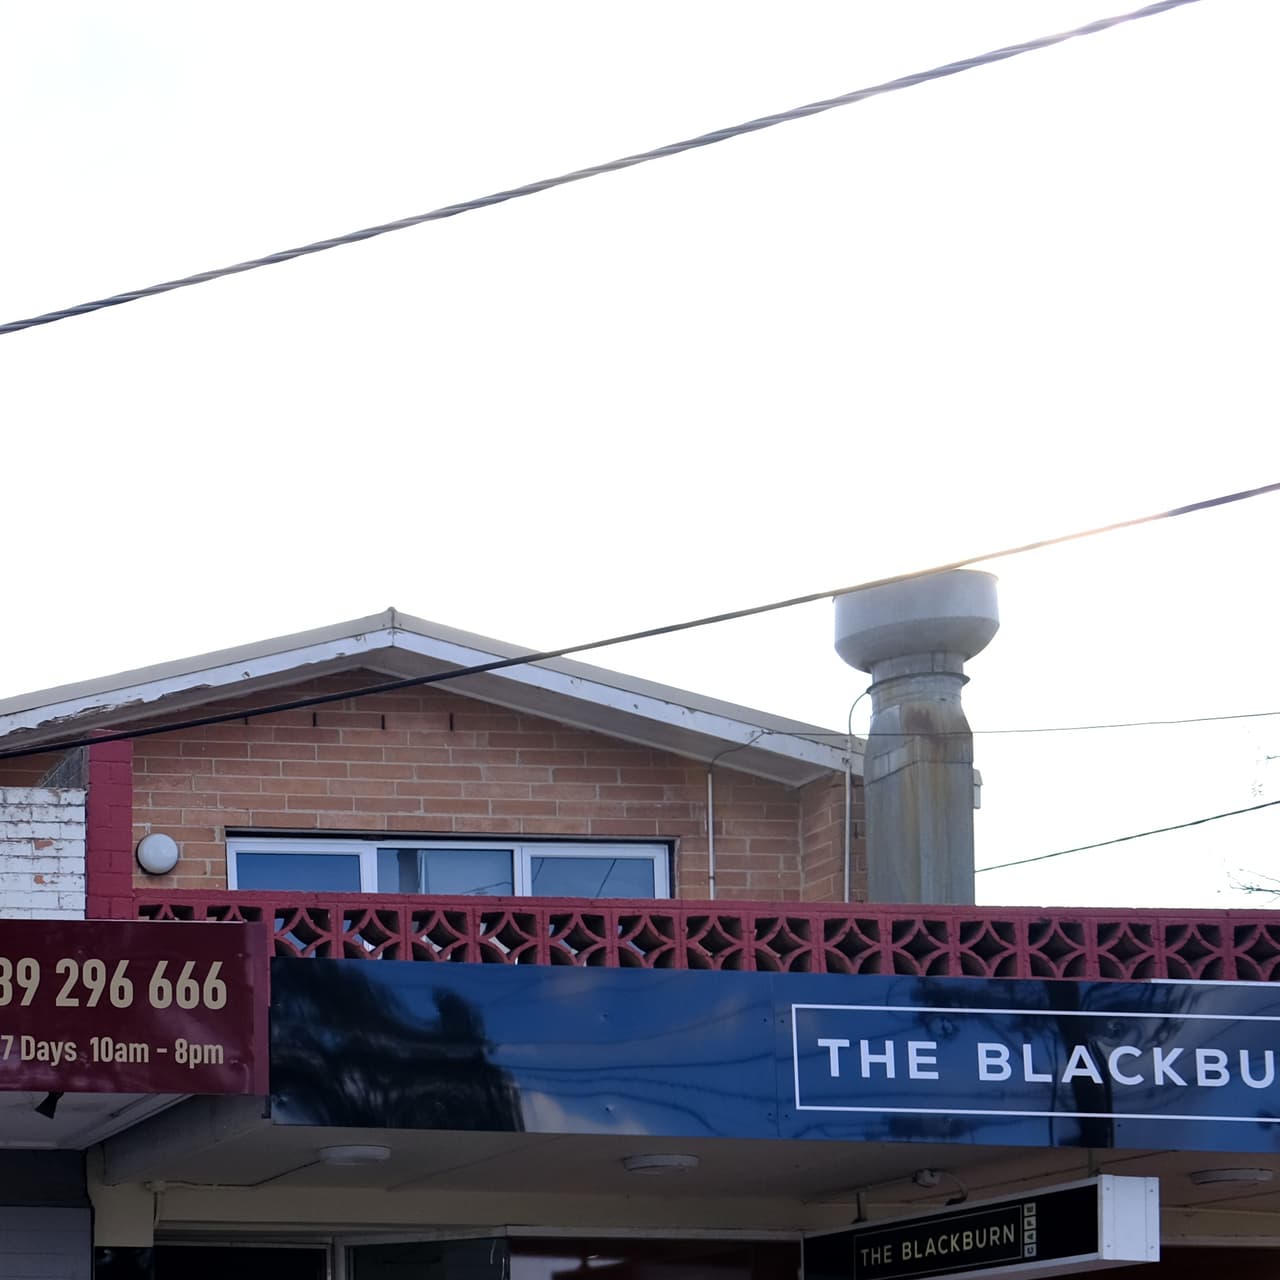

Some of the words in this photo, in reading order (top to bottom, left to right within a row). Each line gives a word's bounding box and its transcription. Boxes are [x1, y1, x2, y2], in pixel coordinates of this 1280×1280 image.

[54, 957, 133, 1009] 296
[147, 959, 228, 1011] 666
[2, 1035, 14, 1062] 7
[20, 1034, 76, 1068] Days
[89, 1036, 150, 1064] 10am
[174, 1037, 224, 1070] 8pm
[818, 1038, 940, 1079] THE
[977, 1043, 1276, 1089] BLACKBU
[860, 1245, 893, 1267] THE
[902, 1224, 1016, 1262] BLACKBURN
